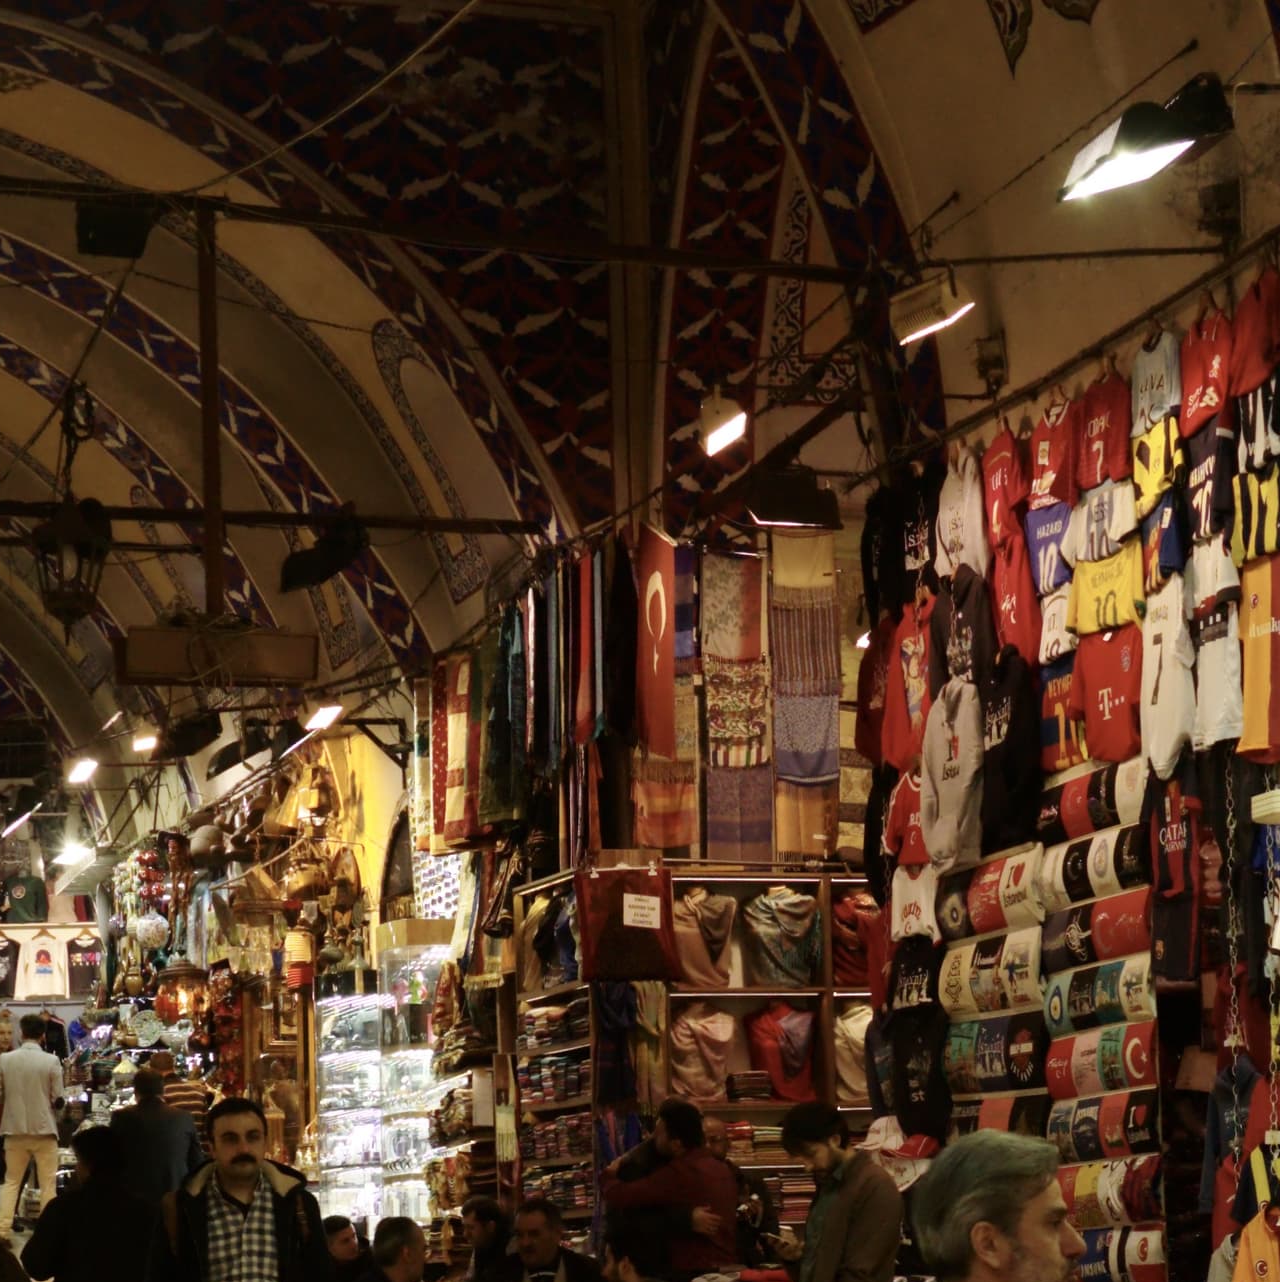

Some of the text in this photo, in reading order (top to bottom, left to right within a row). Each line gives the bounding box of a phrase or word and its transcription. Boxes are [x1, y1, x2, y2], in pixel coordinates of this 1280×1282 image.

[1092, 441, 1104, 483] 7
[1036, 520, 1063, 540] HAZARD
[1038, 542, 1058, 596] 10
[1151, 633, 1163, 706] 7
